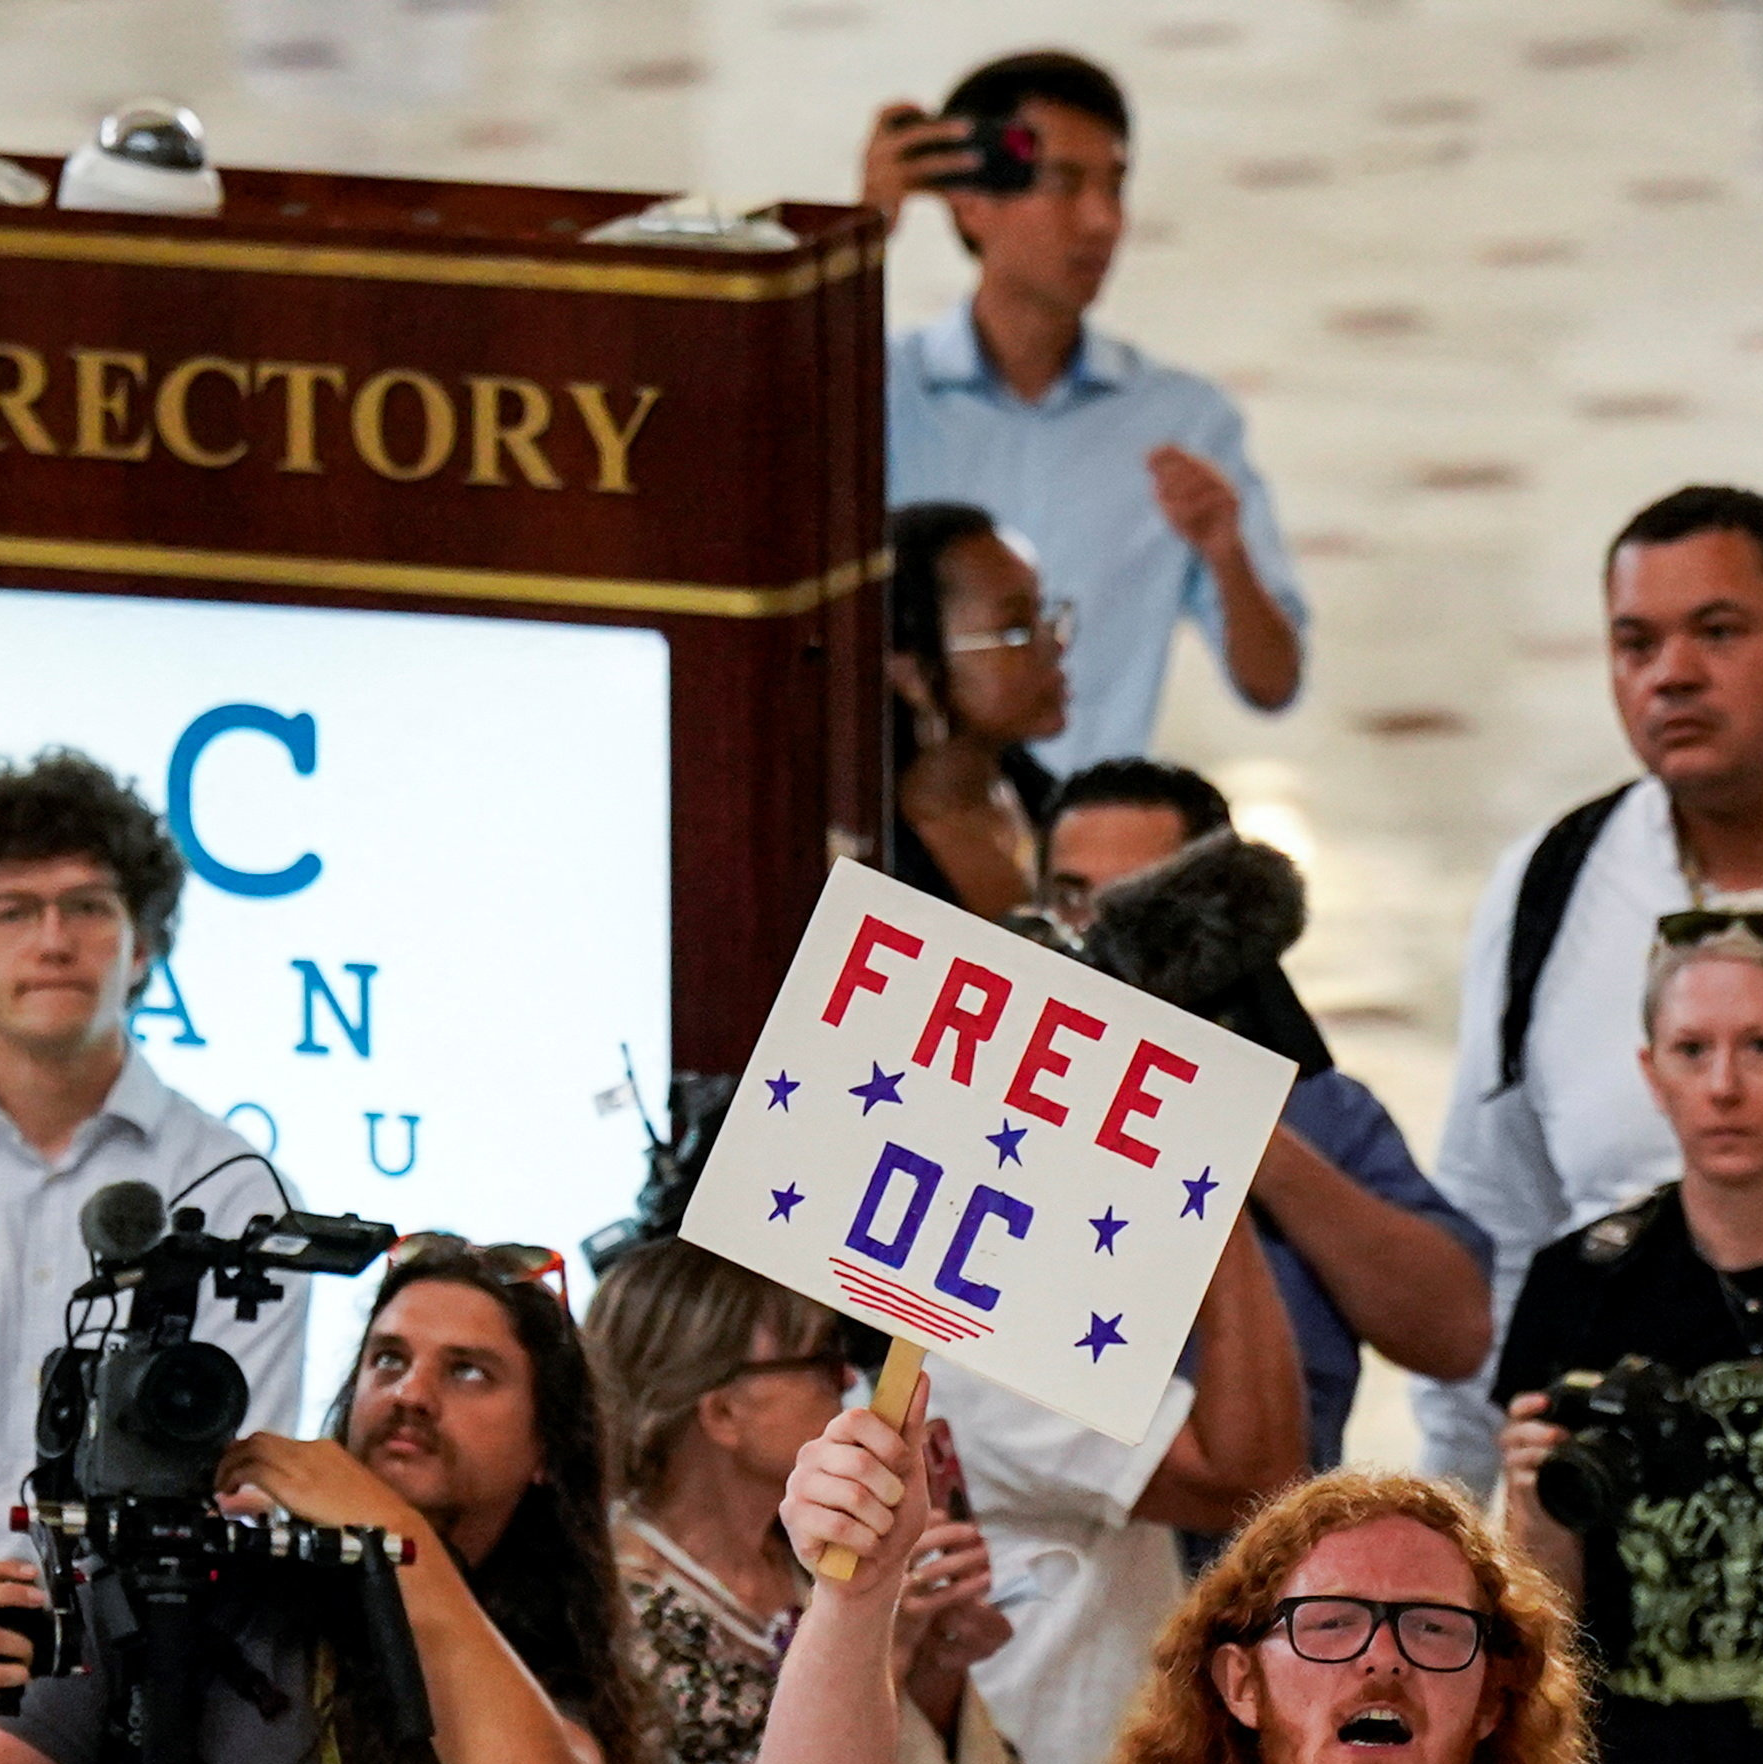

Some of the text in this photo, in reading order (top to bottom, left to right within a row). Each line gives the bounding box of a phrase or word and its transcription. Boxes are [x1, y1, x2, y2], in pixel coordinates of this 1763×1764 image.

[167, 702, 324, 899] C
[820, 913, 1200, 1170] FREE
[844, 1140, 1035, 1313] DC
